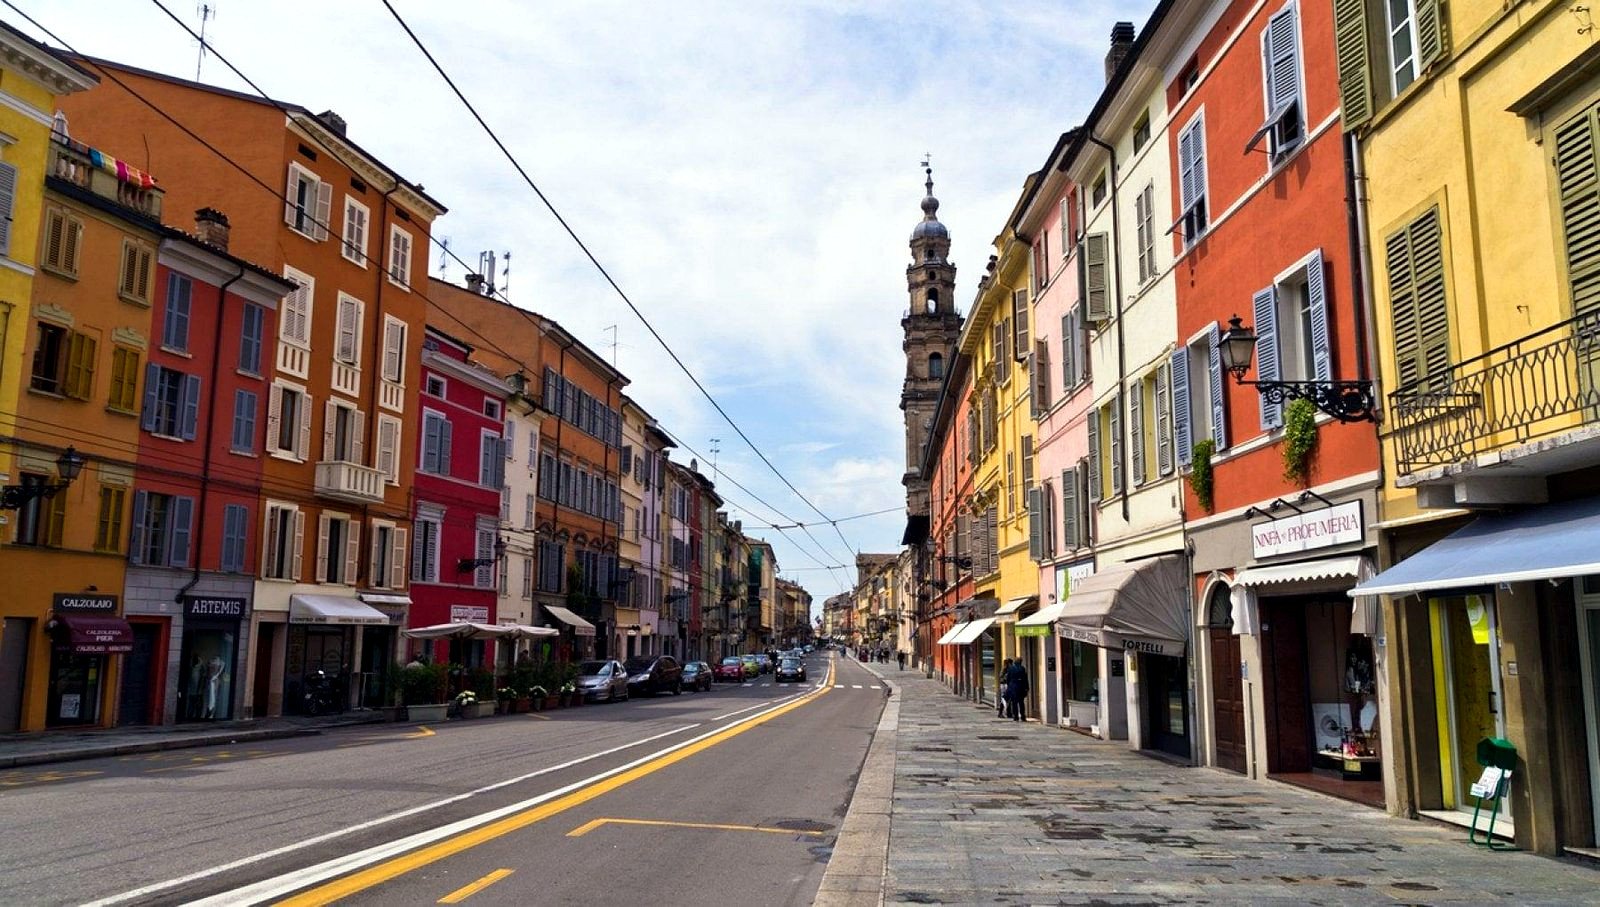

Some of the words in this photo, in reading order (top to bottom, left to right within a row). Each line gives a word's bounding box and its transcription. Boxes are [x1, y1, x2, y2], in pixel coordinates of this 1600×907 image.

[1255, 530, 1281, 547] NINFA
[1288, 514, 1358, 542] PROFUMERIA
[62, 598, 112, 609] CALZOLAIO
[191, 600, 240, 614] ARTEMIS
[1121, 639, 1163, 653] TORTELLI
